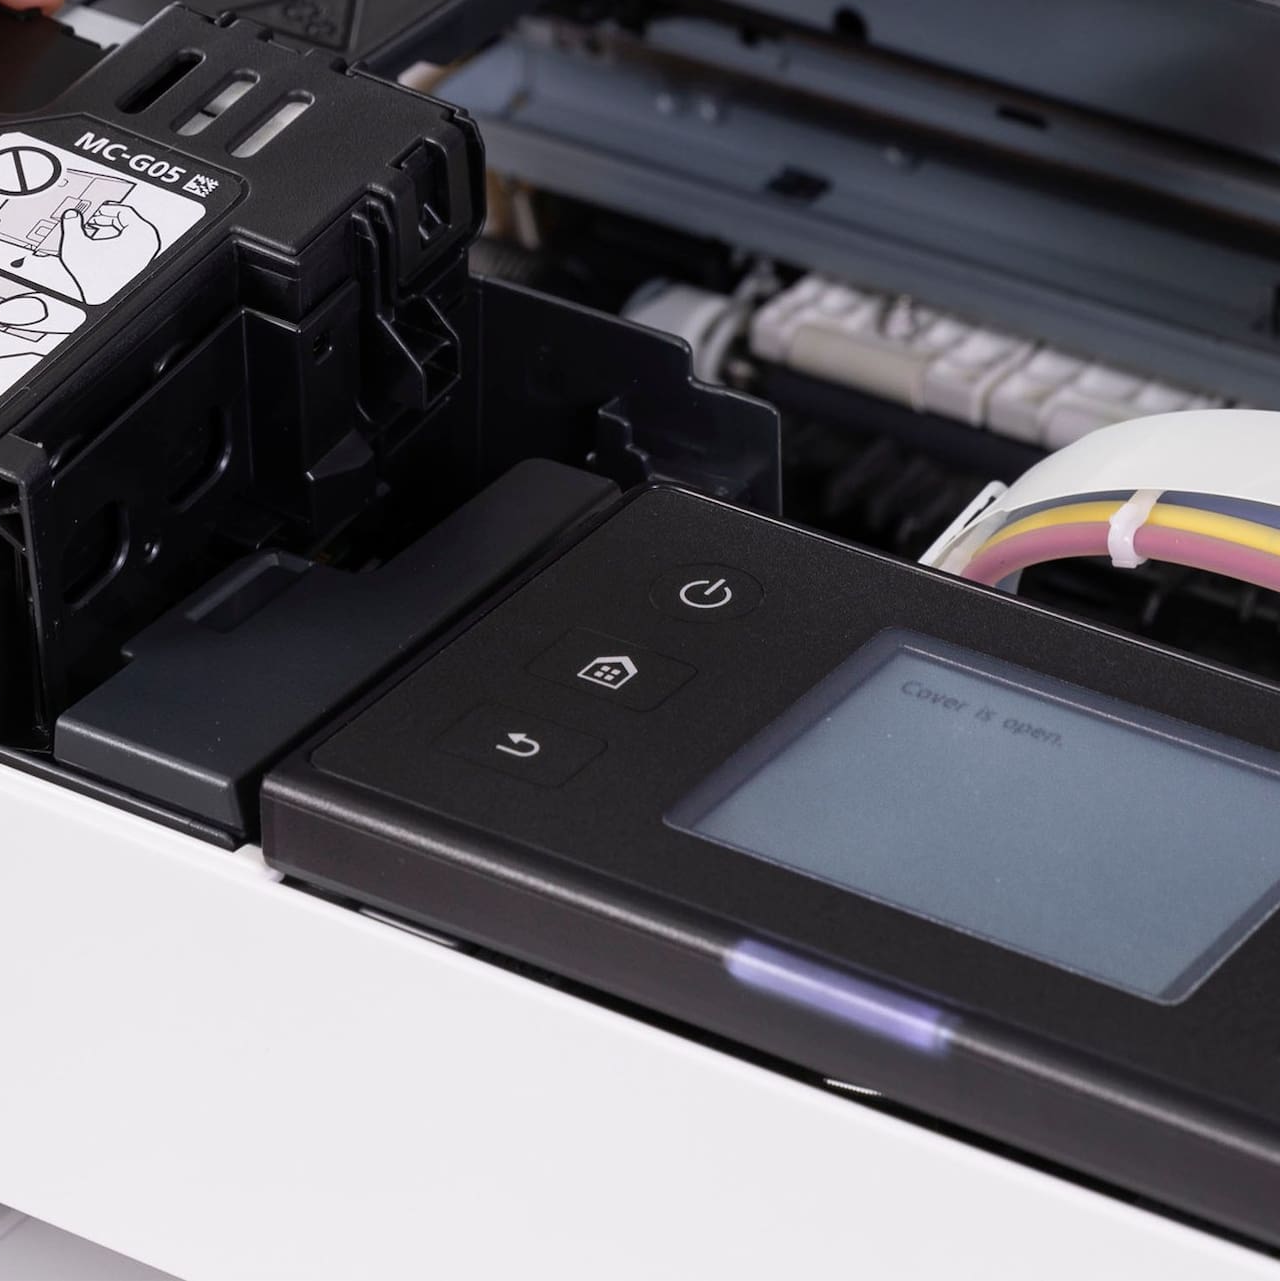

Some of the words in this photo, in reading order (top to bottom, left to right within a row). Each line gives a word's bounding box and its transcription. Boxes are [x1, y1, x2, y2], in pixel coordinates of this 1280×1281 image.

[74, 131, 187, 183] MC-G05
[901, 680, 970, 713] Cover
[974, 705, 998, 722] is
[1003, 719, 1062, 747] open.
